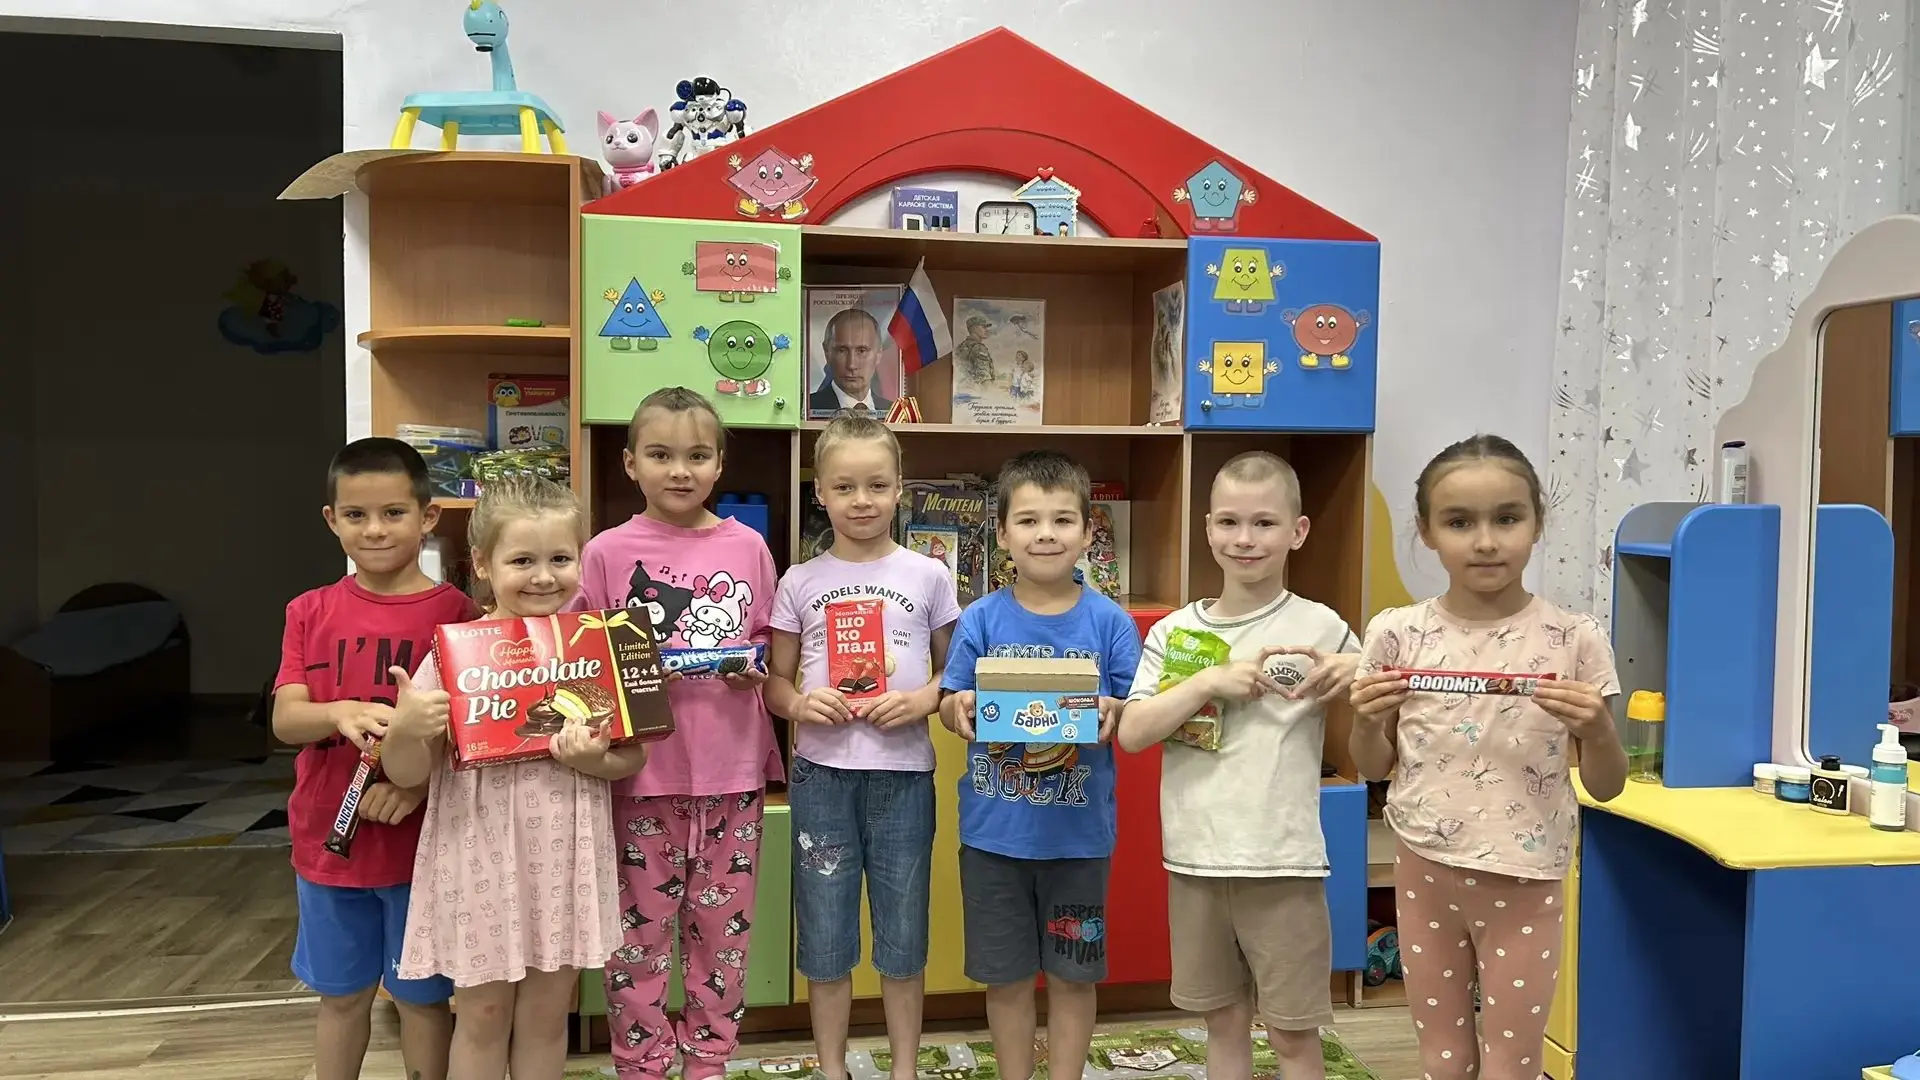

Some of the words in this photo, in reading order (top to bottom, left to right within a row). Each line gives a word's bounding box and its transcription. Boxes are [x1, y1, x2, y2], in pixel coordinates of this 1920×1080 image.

[913, 194, 940, 202] ДЕТСКАЯ
[898, 201, 926, 209] КАРАОКЕ
[927, 202, 954, 210] СИСТЕМА
[811, 584, 861, 612] MODELS
[864, 585, 915, 613] WANTED
[835, 616, 865, 628] шо
[460, 626, 503, 638] LOTTE
[835, 629, 860, 641] ко
[618, 641, 650, 652] Limited
[836, 641, 877, 654] лад
[620, 651, 650, 662] Edition
[456, 656, 602, 694] Chocolate
[638, 678, 662, 686] больше
[630, 684, 659, 694] счастья!
[463, 694, 517, 725] Pie
[983, 704, 996, 716] 18
[1014, 711, 1059, 729] Барни
[465, 742, 477, 752] 16
[353, 762, 370, 791] SUPER
[335, 786, 360, 833] SNICKERS
